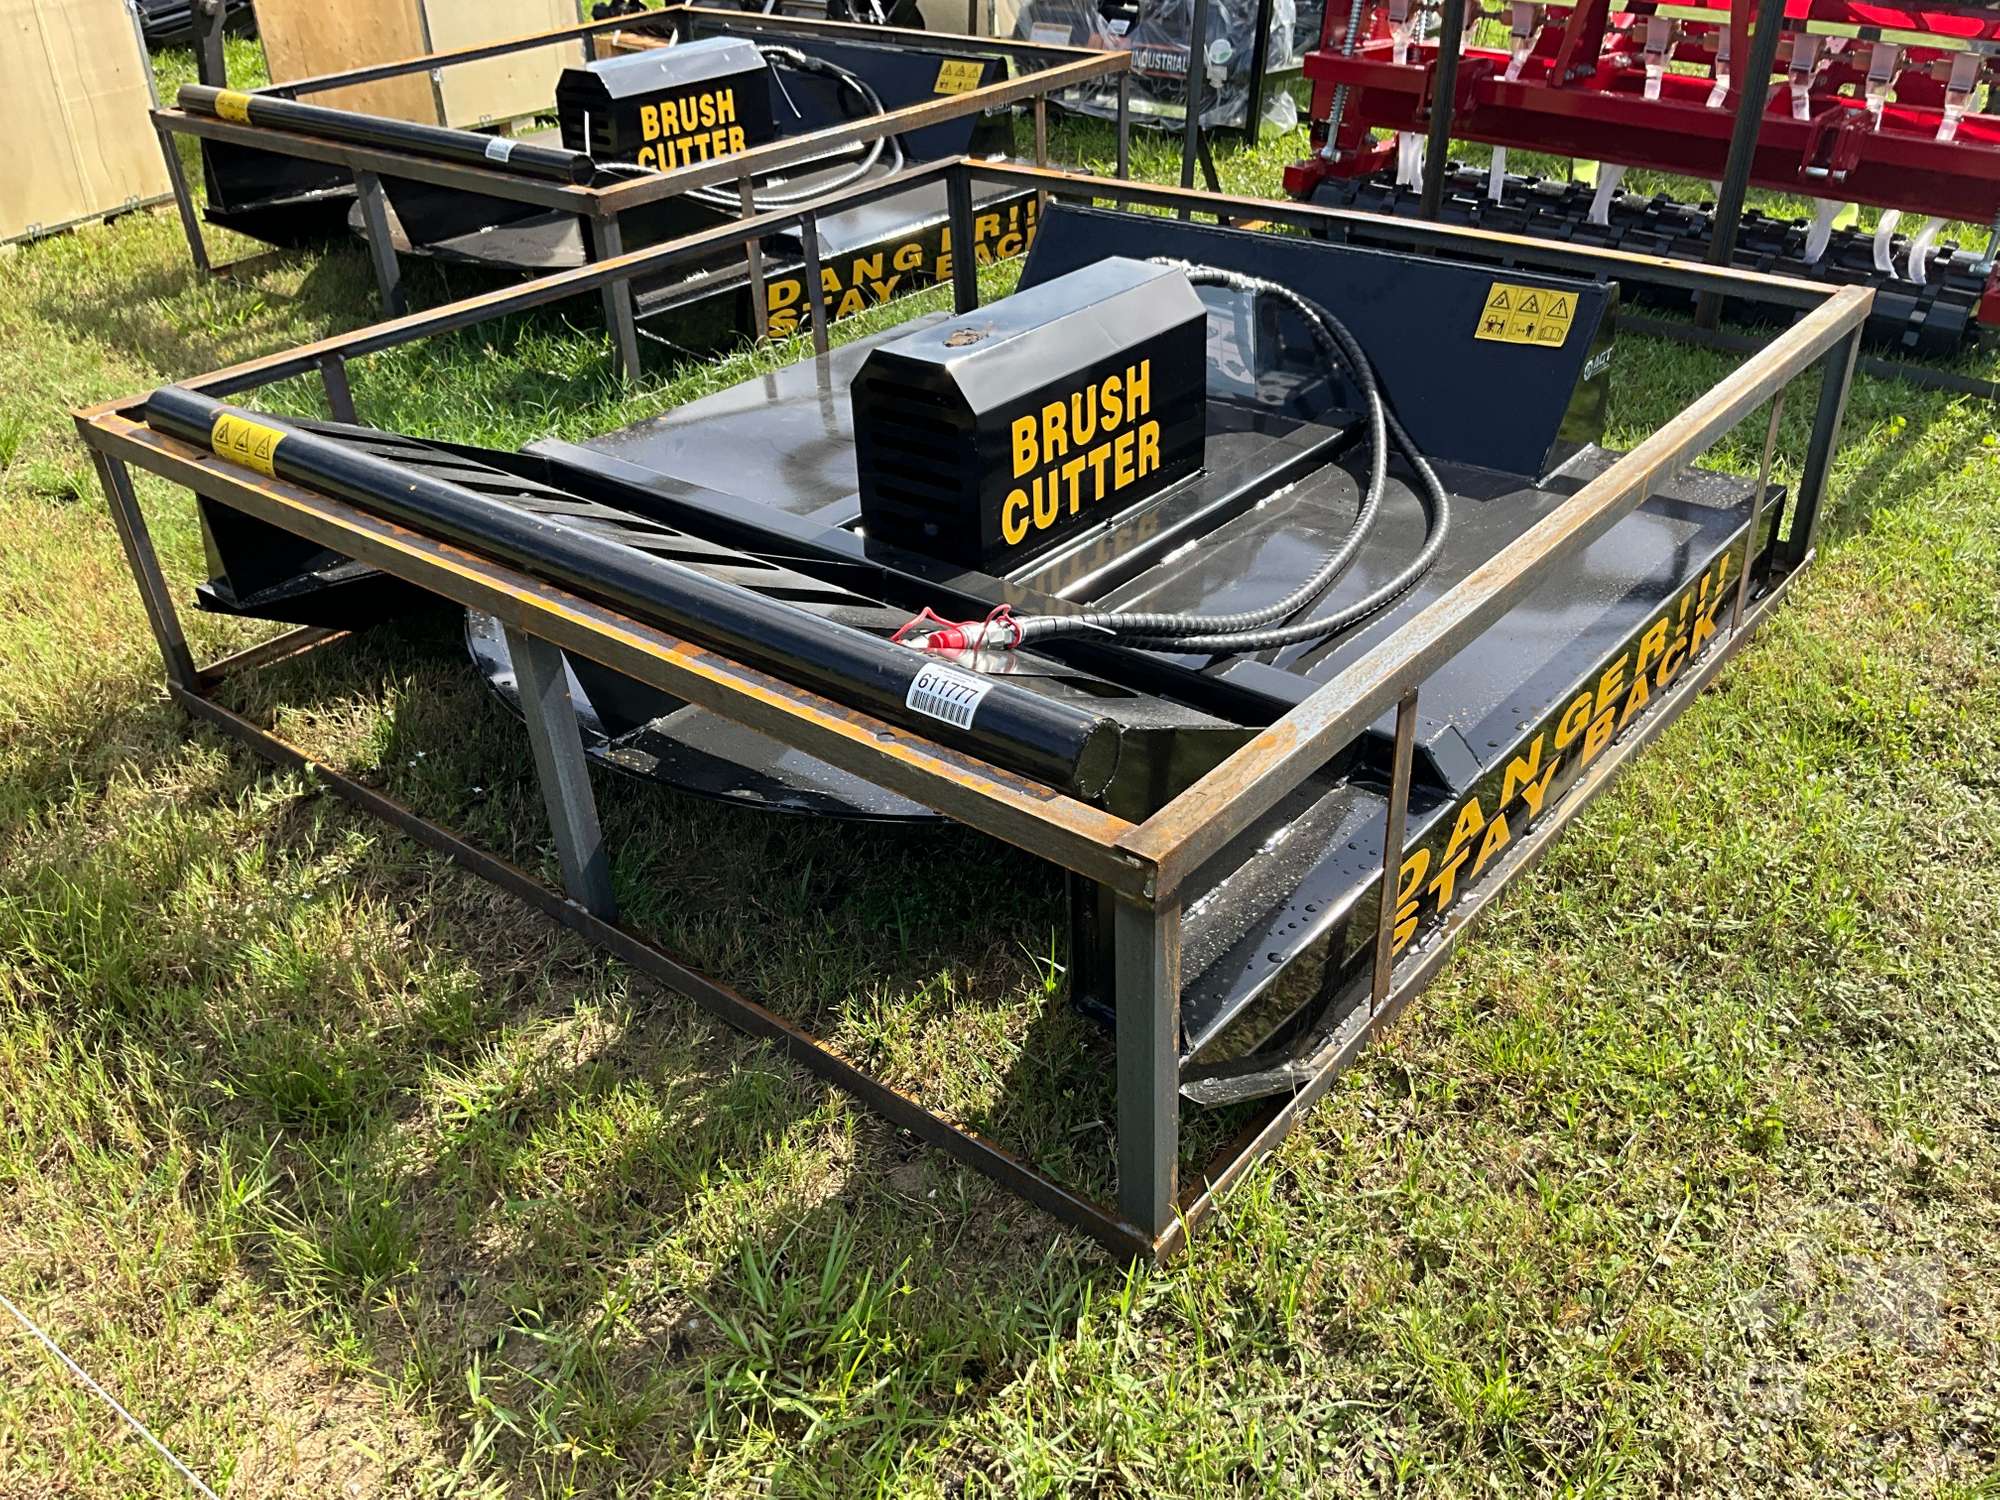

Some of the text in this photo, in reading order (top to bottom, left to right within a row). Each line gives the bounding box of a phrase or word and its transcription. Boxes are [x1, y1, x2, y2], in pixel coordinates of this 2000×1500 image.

[1130, 49, 1188, 73] INDUSTRIAL
[640, 88, 736, 142] BRUSH
[1011, 358, 1151, 480] BRUSH
[1001, 419, 1161, 546] CUTTER
[918, 673, 979, 704] 611777
[1391, 595, 1722, 958] STAY BACK
